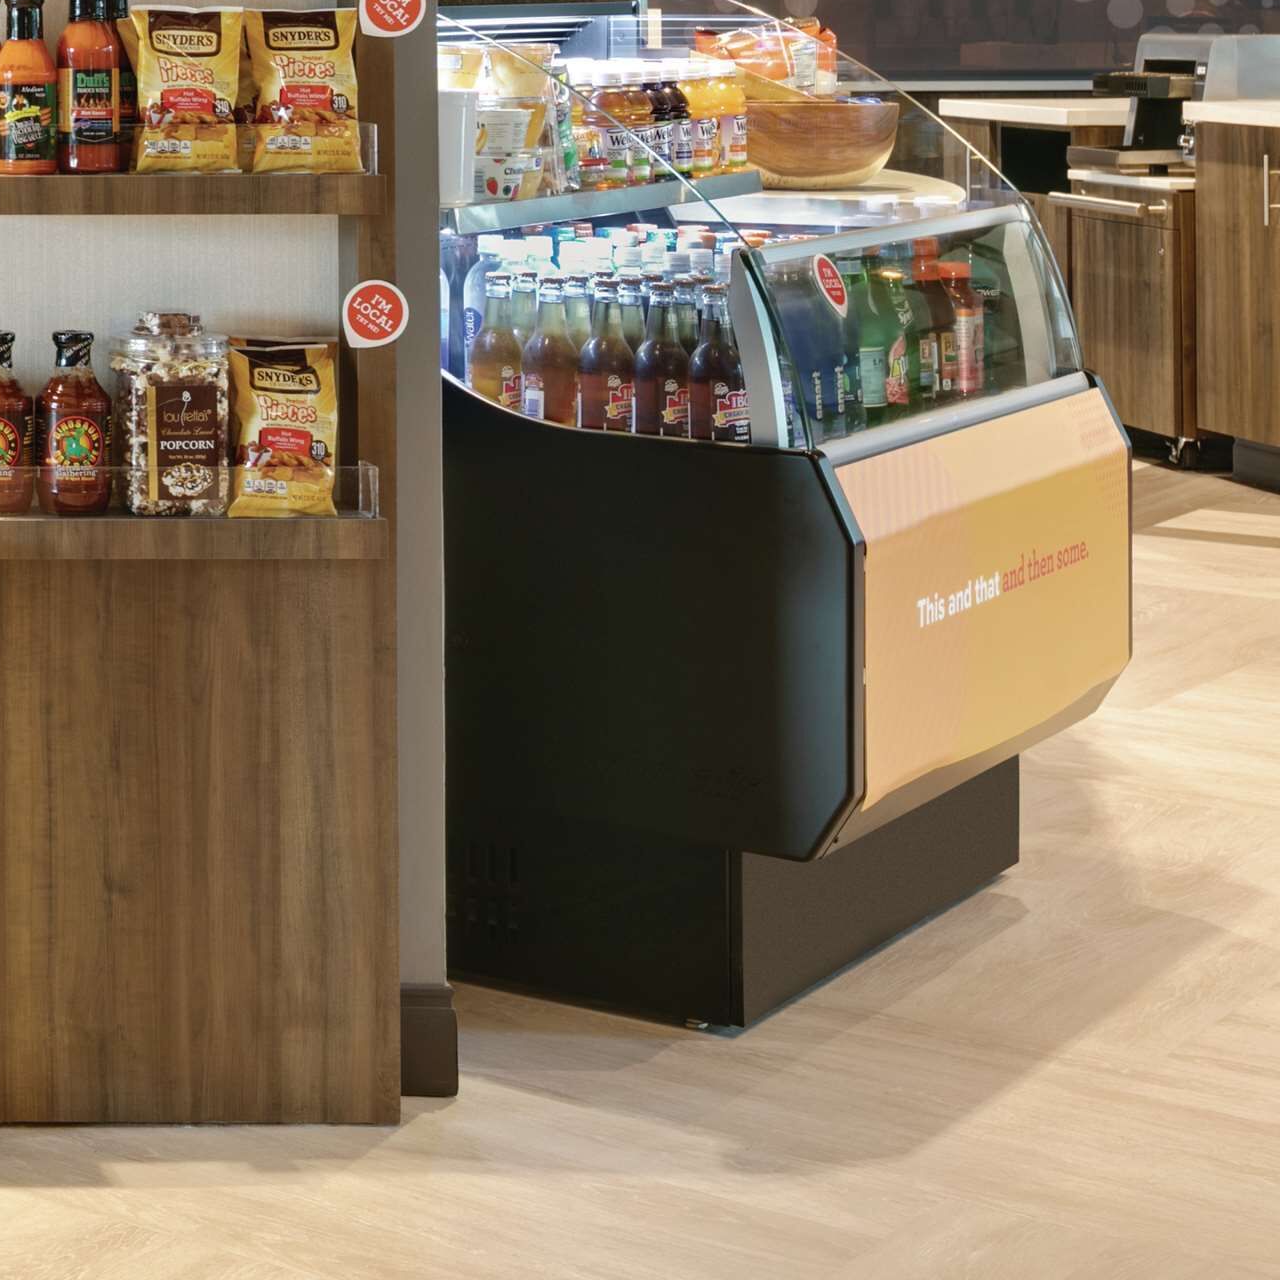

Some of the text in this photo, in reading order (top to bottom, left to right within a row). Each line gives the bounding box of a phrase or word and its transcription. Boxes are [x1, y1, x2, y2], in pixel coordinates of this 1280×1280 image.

[155, 32, 213, 47] SNYDER'S
[272, 30, 331, 42] SNYDER'S
[158, 57, 214, 84] Pieces
[274, 53, 335, 79] Pieces
[333, 96, 346, 109] 310
[352, 297, 394, 332] LOCAL
[370, 294, 392, 314] I'M
[812, 371, 823, 420] smart
[257, 395, 317, 423] Pieces
[160, 439, 215, 450] POPCORN
[312, 442, 326, 456] 310
[917, 540, 1089, 628] This and that and then some.
